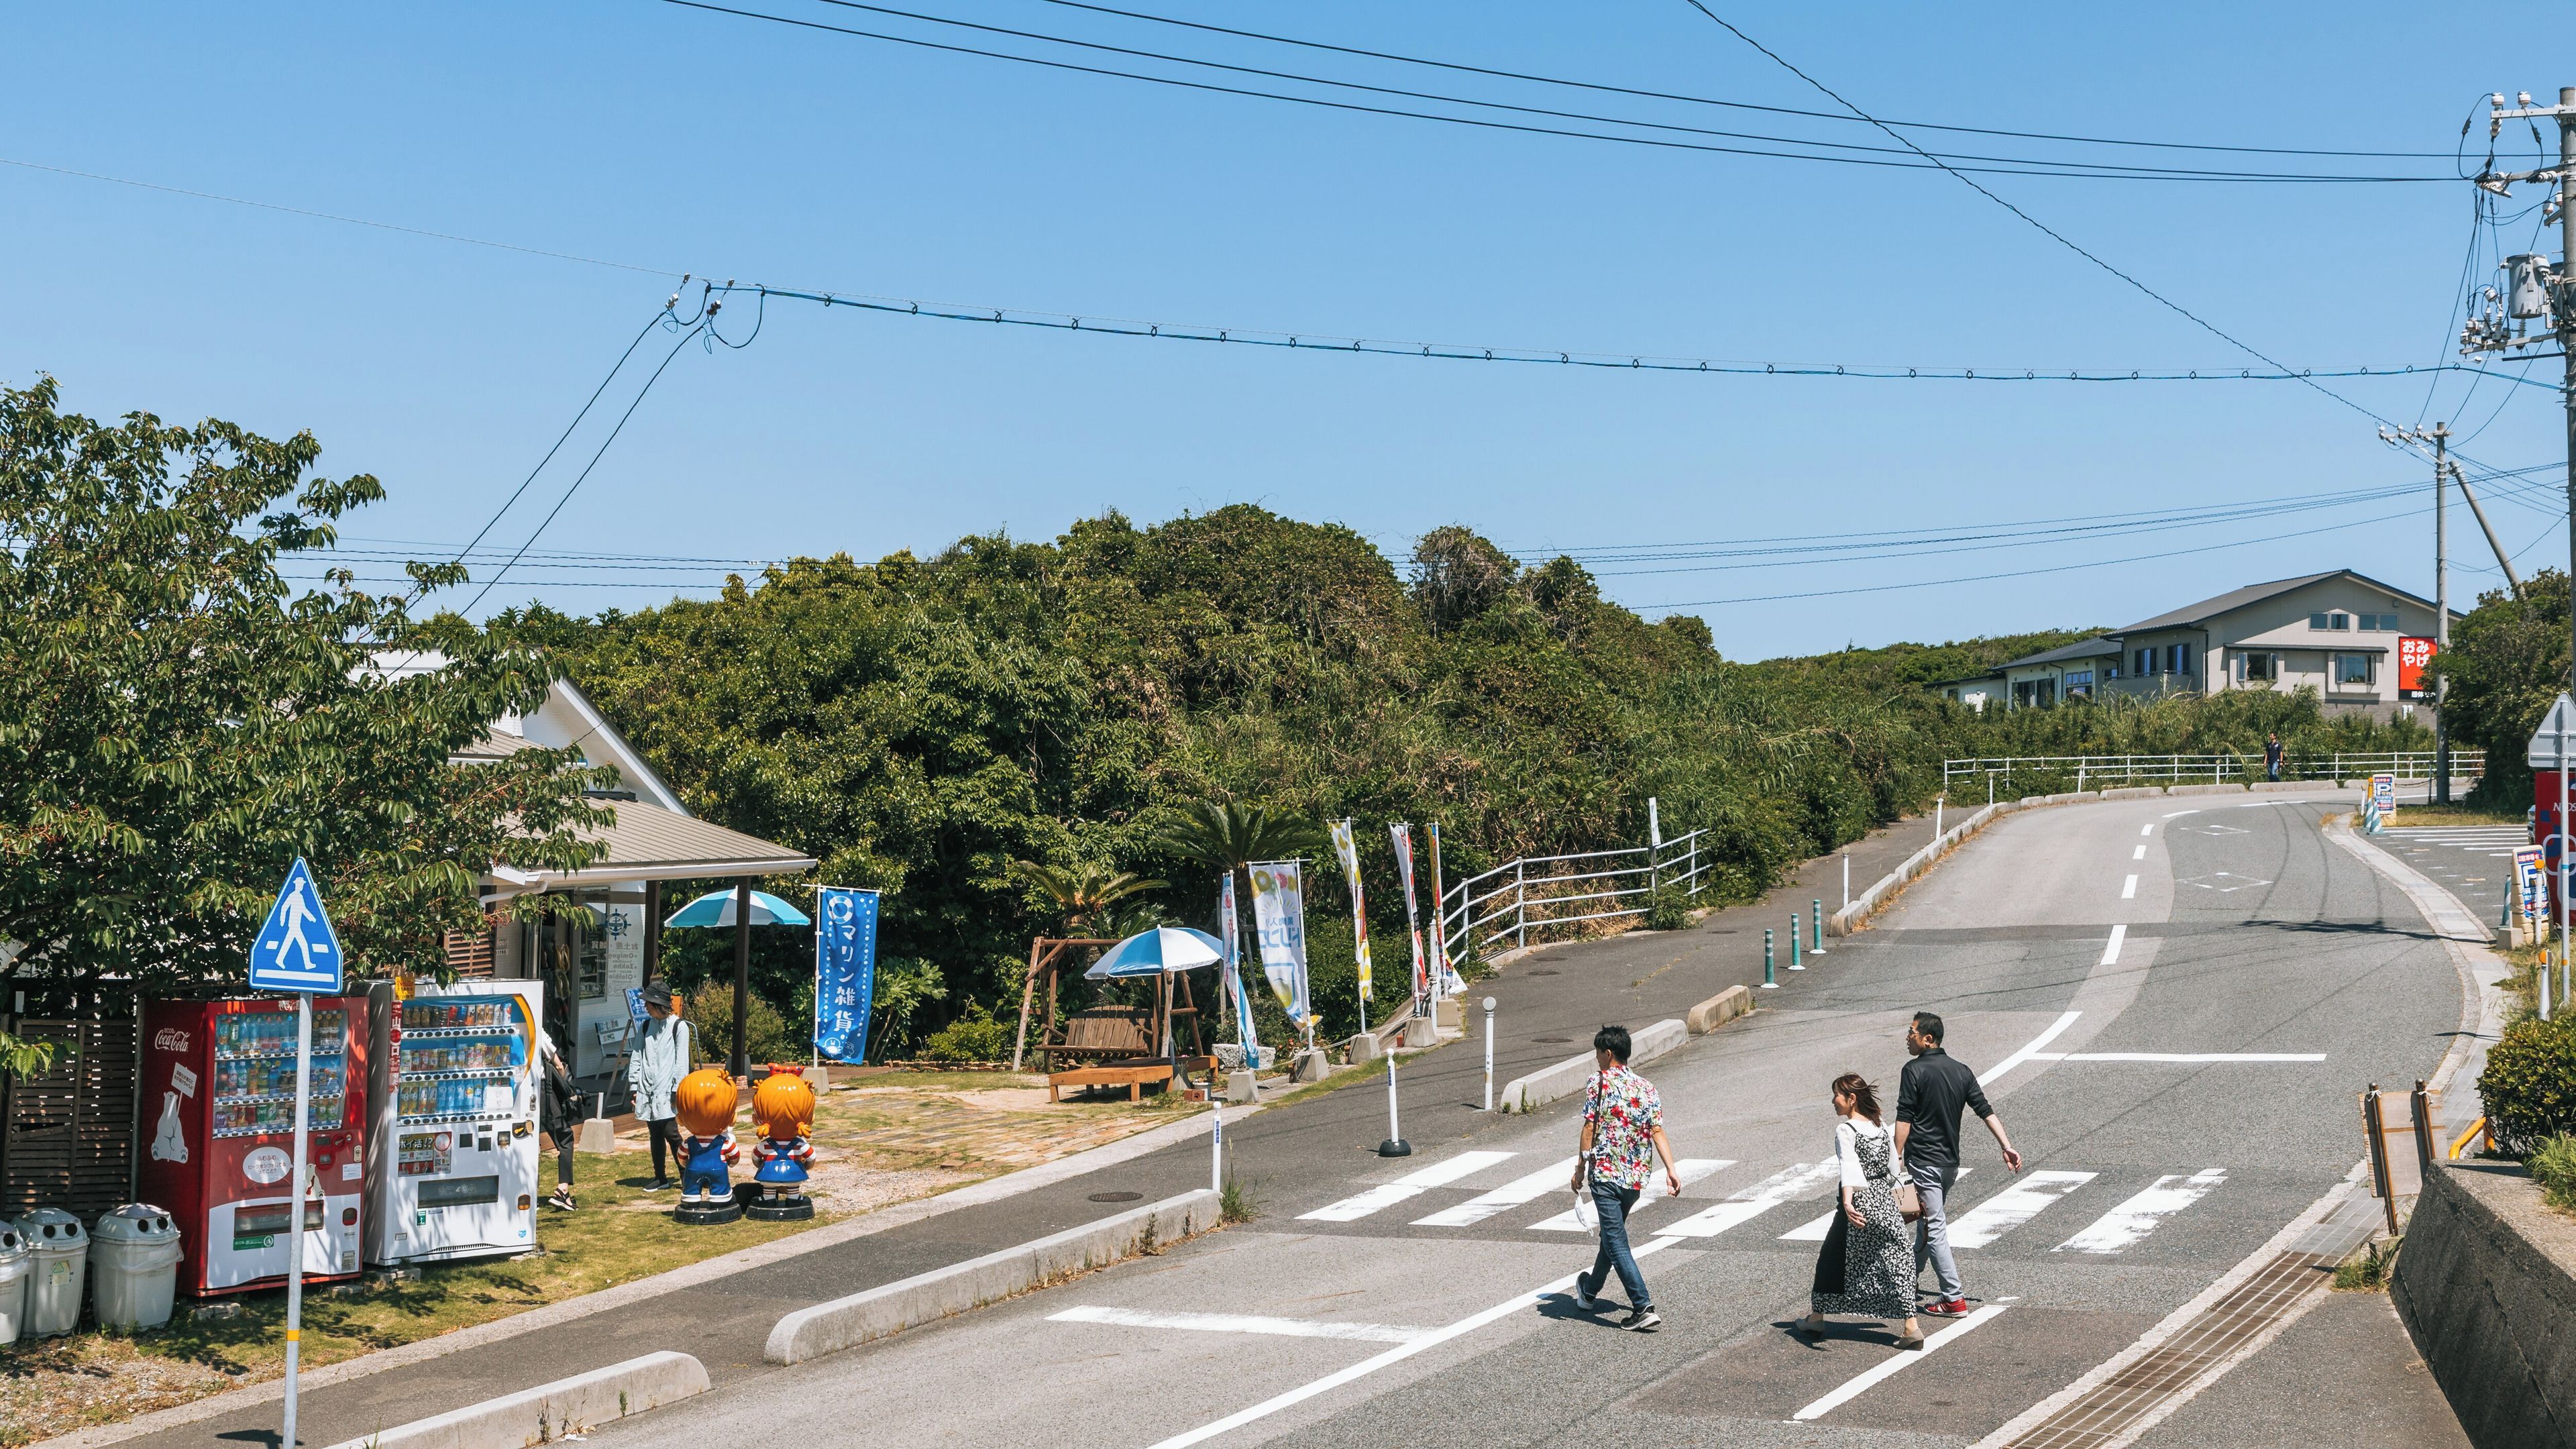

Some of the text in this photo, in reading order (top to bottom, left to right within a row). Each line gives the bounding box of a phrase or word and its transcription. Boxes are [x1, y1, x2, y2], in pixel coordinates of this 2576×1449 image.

[2402, 640, 2430, 654] おみ
[834, 924, 856, 1033] マリン雑貨
[154, 1029, 191, 1053] Coca-Cola
